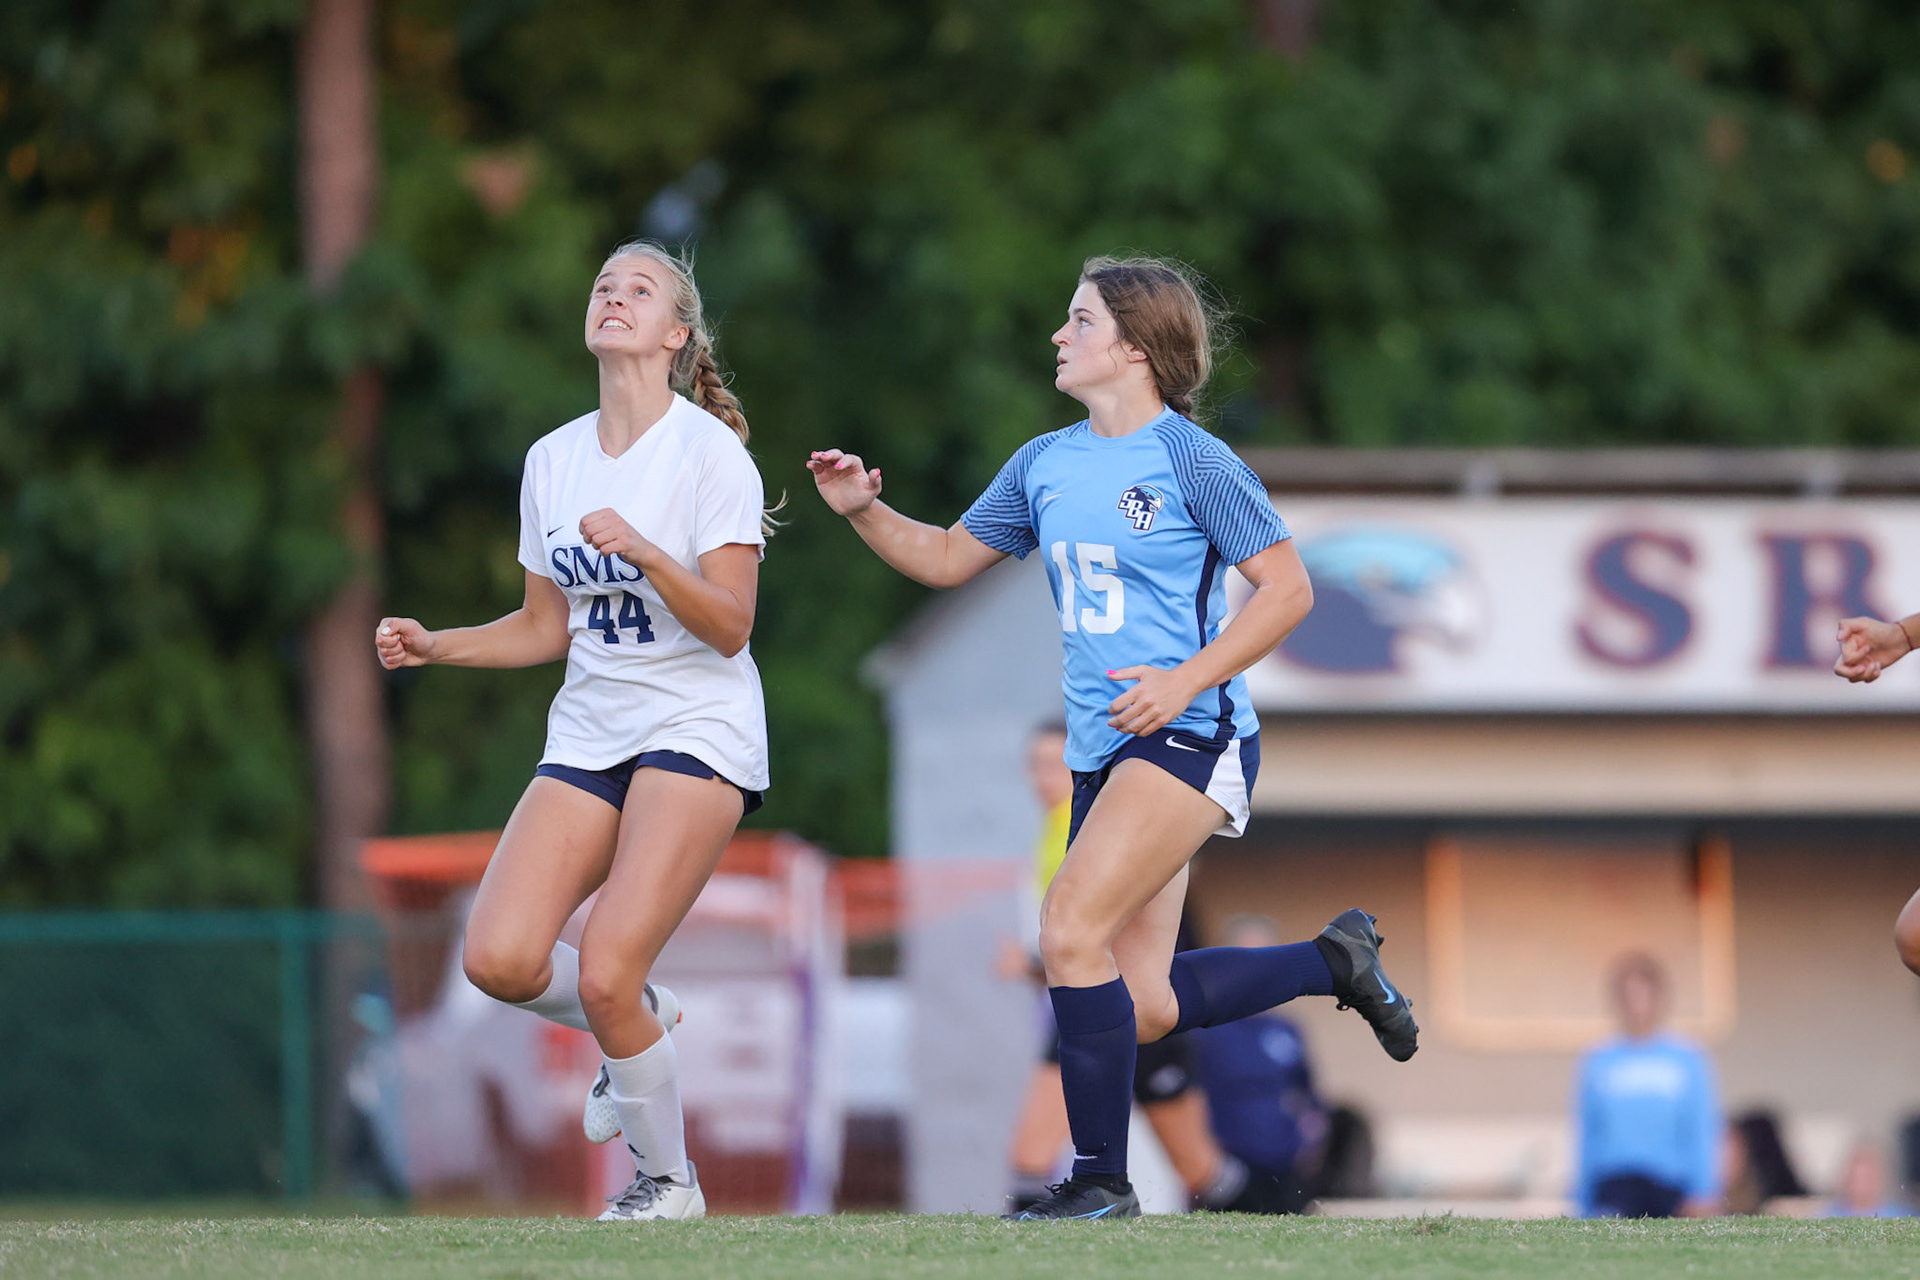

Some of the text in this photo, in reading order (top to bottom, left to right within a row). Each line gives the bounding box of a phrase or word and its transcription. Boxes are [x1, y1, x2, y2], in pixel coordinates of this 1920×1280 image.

[551, 546, 645, 588] SMS
[1051, 541, 1124, 634] 15
[588, 590, 656, 644] 44
